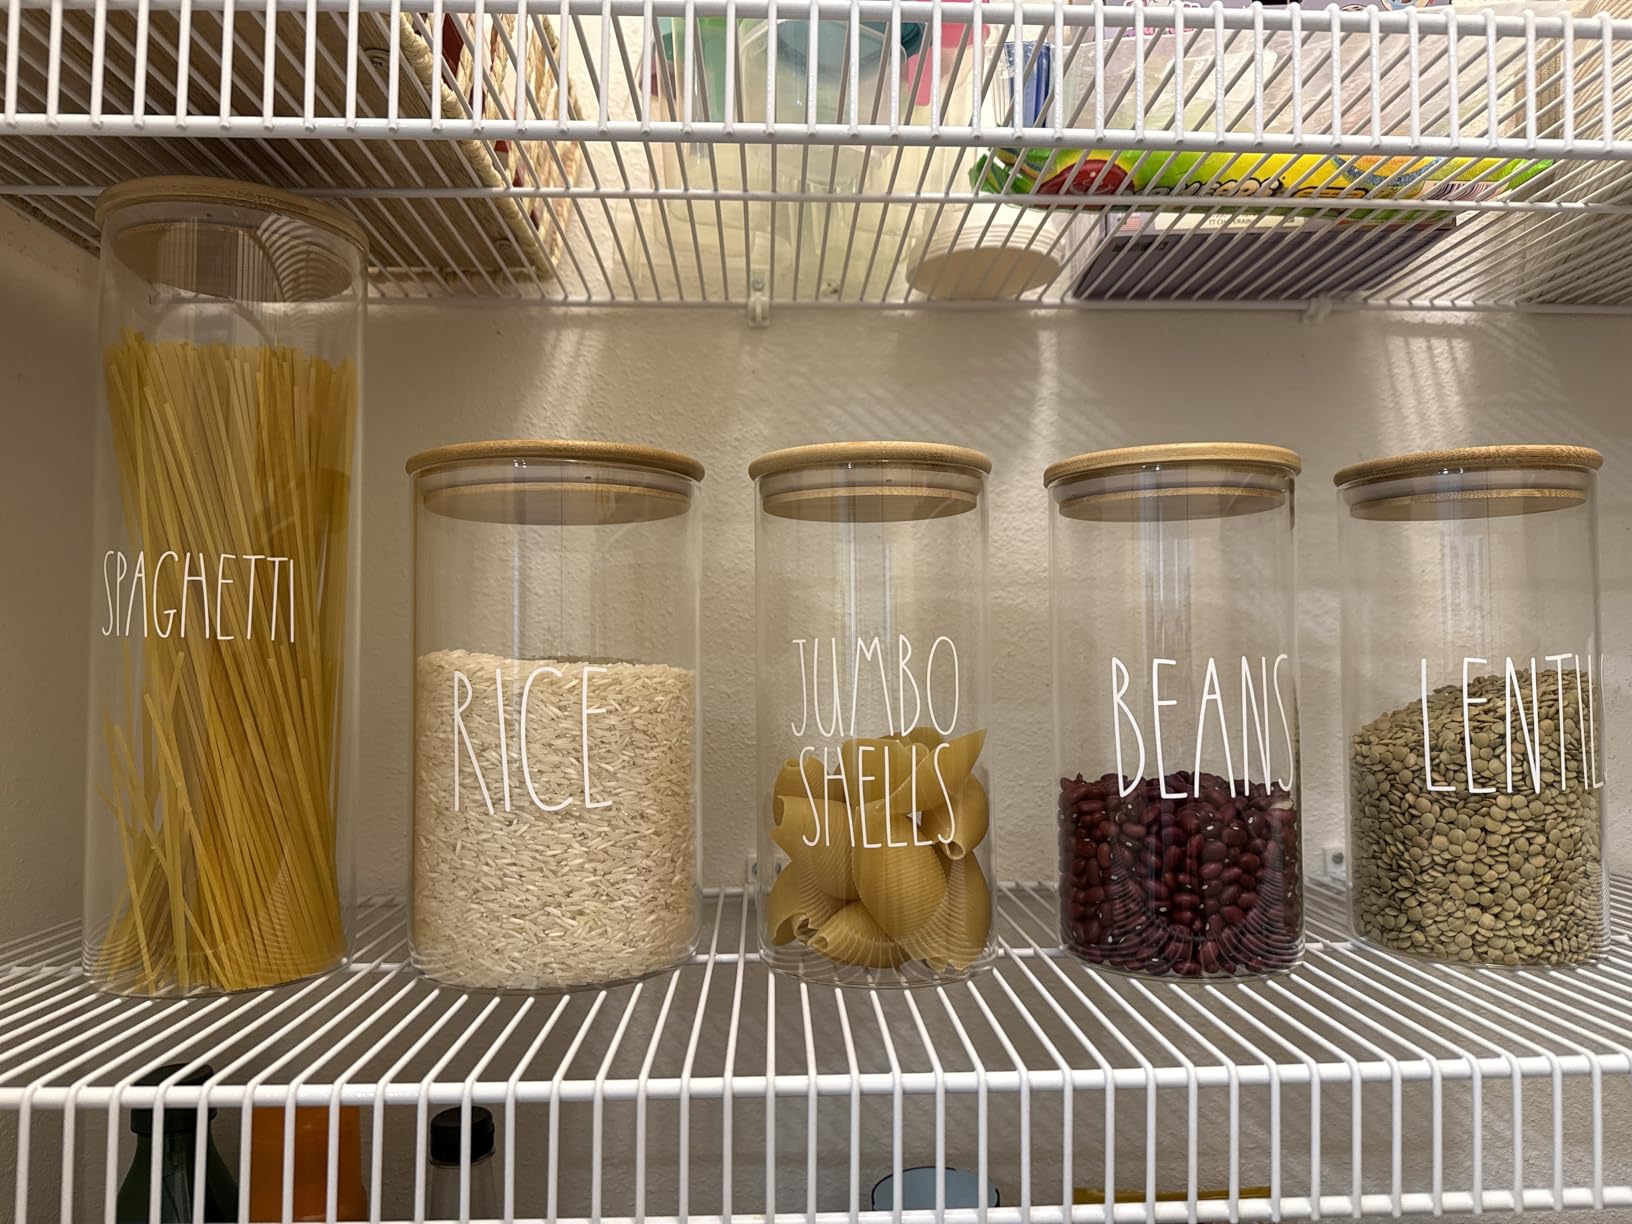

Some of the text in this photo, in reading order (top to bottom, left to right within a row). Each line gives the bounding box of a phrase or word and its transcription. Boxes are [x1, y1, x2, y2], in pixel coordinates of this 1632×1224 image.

[102, 551, 294, 643] SPAGHETTI
[454, 666, 613, 815] RICE
[791, 634, 958, 737] JUMBO
[1112, 653, 1293, 799] BEANS
[1421, 652, 1608, 794] LENTIL
[800, 743, 955, 848] SHELLS
